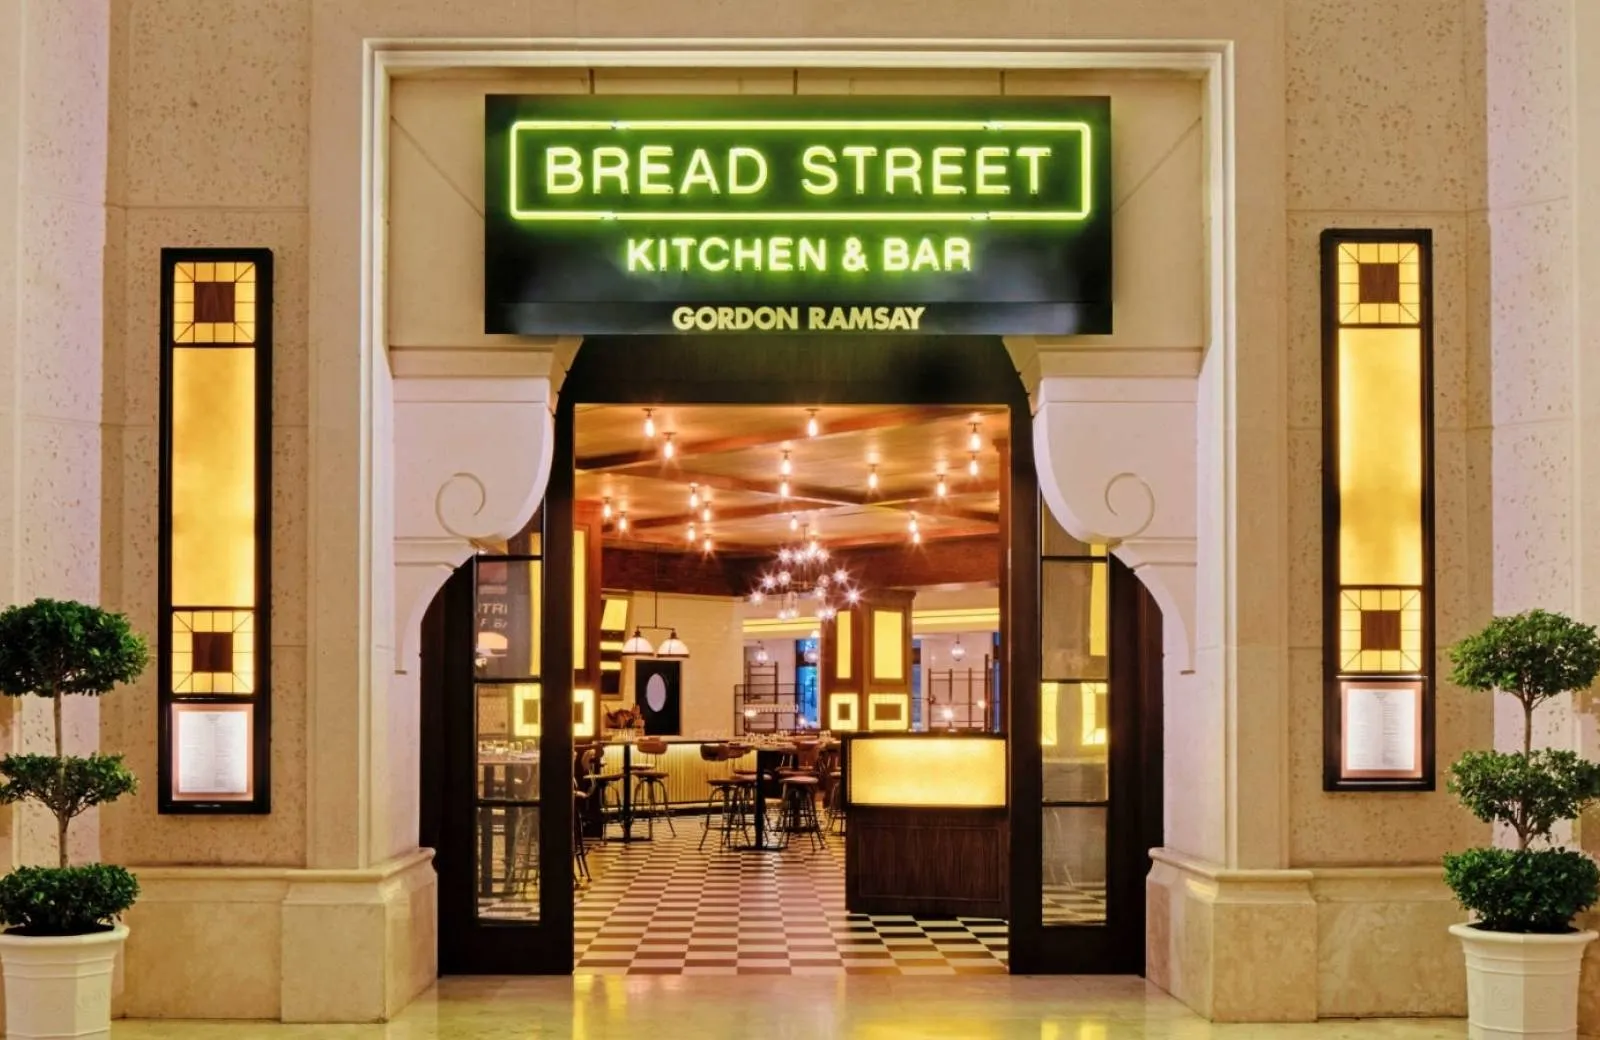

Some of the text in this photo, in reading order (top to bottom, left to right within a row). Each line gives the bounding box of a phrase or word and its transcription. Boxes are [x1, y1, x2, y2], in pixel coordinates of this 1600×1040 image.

[546, 145, 1052, 195] BREAD STREET
[627, 237, 972, 272] KITCHEN & BAR
[672, 306, 925, 331] GORDON RAMSAY
